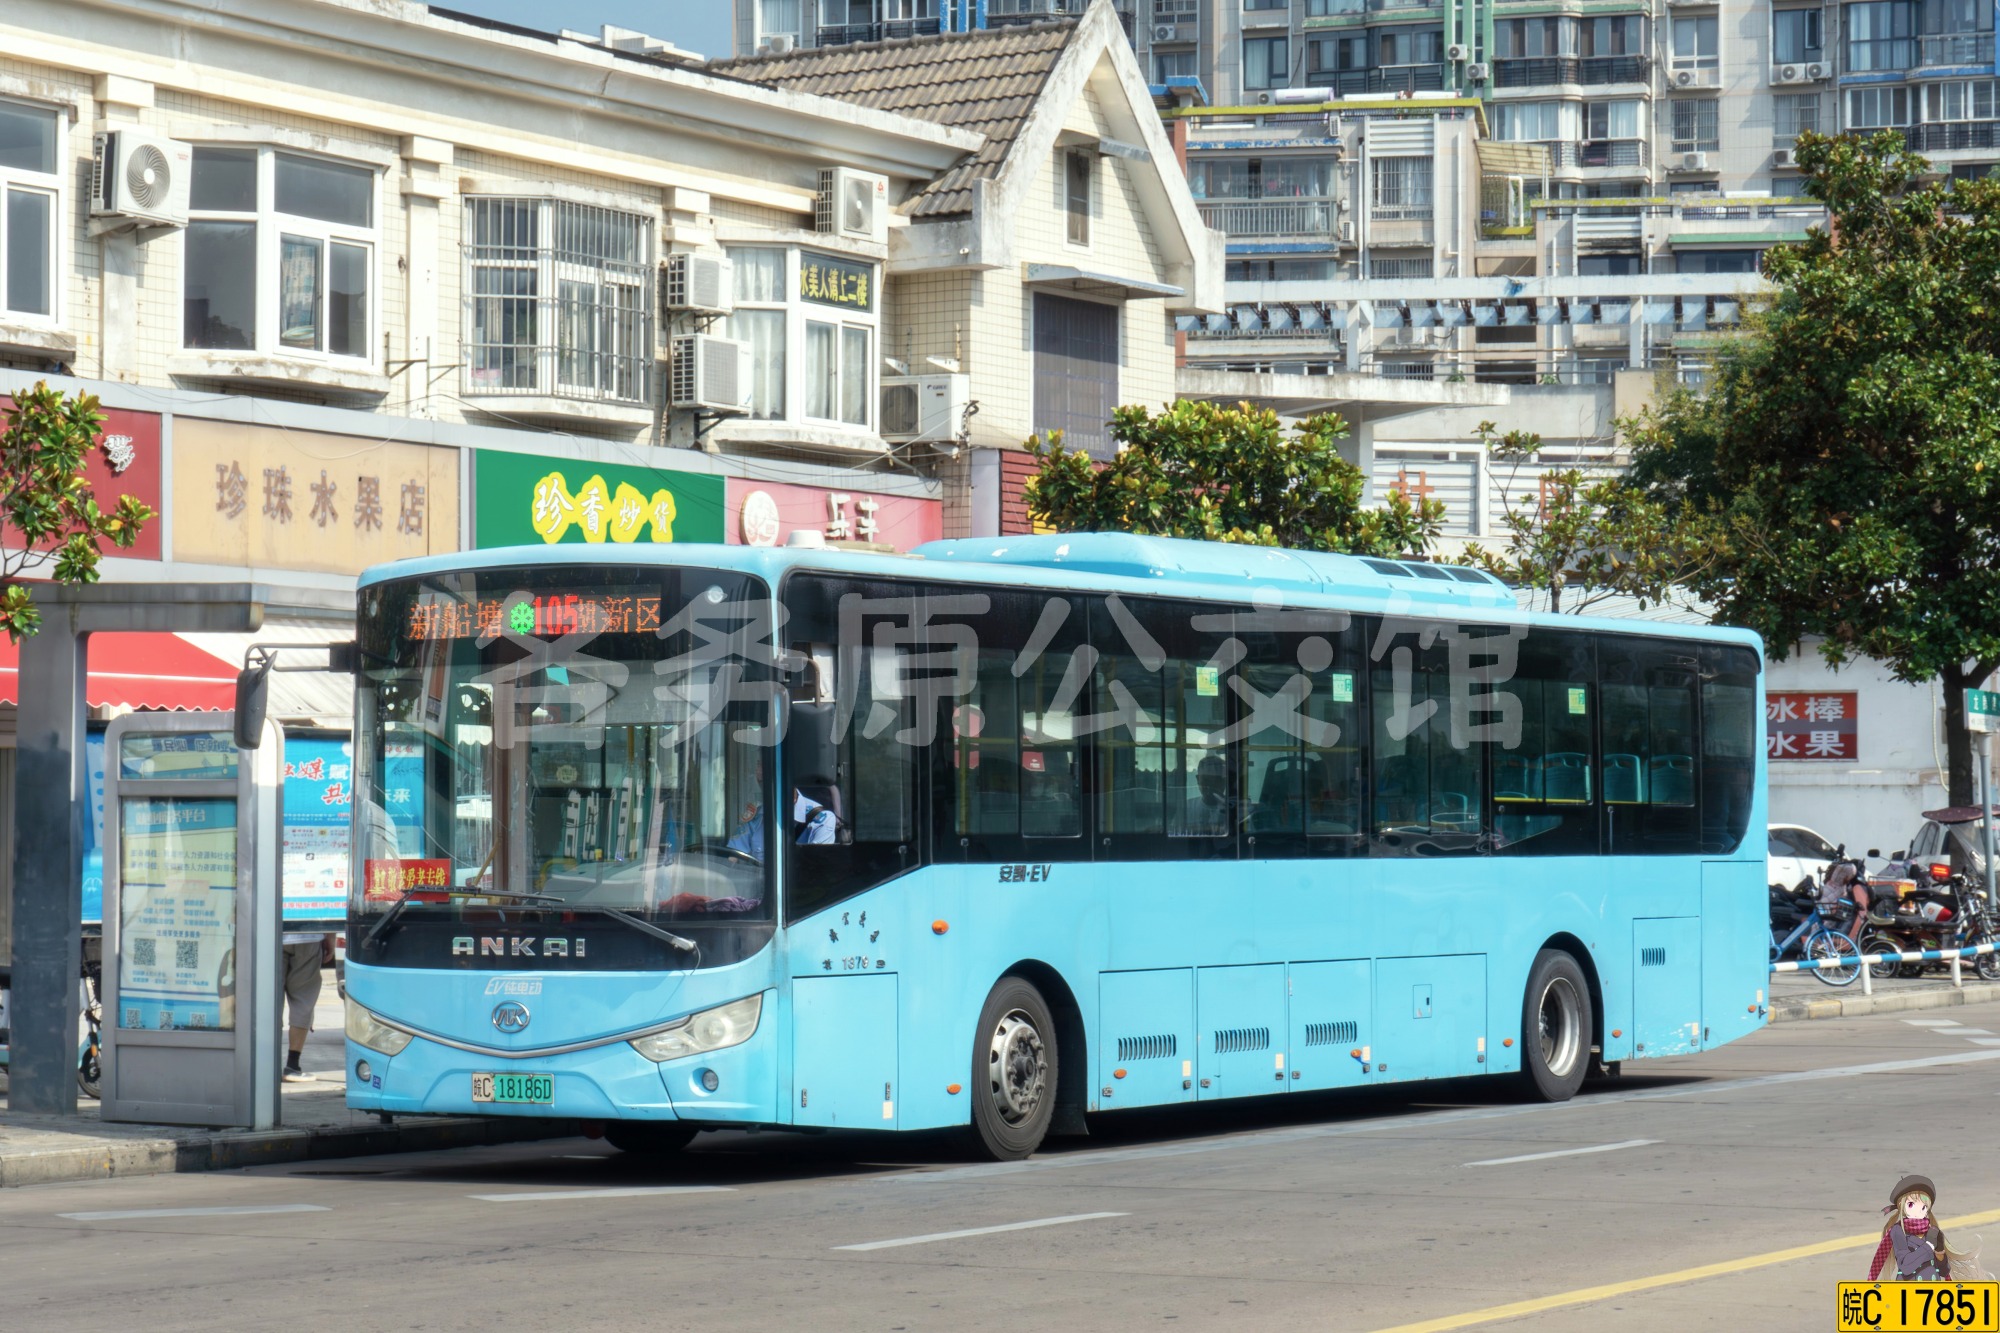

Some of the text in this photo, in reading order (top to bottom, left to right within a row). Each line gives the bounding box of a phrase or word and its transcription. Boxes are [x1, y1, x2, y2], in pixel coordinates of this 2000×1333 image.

[216, 460, 425, 536] 珍珠水果店
[535, 478, 671, 536] 珍香炒货
[409, 600, 503, 639] 新船塘
[534, 595, 578, 635] 105
[452, 936, 586, 957] ANKAI
[499, 1078, 552, 1099] 18186D
